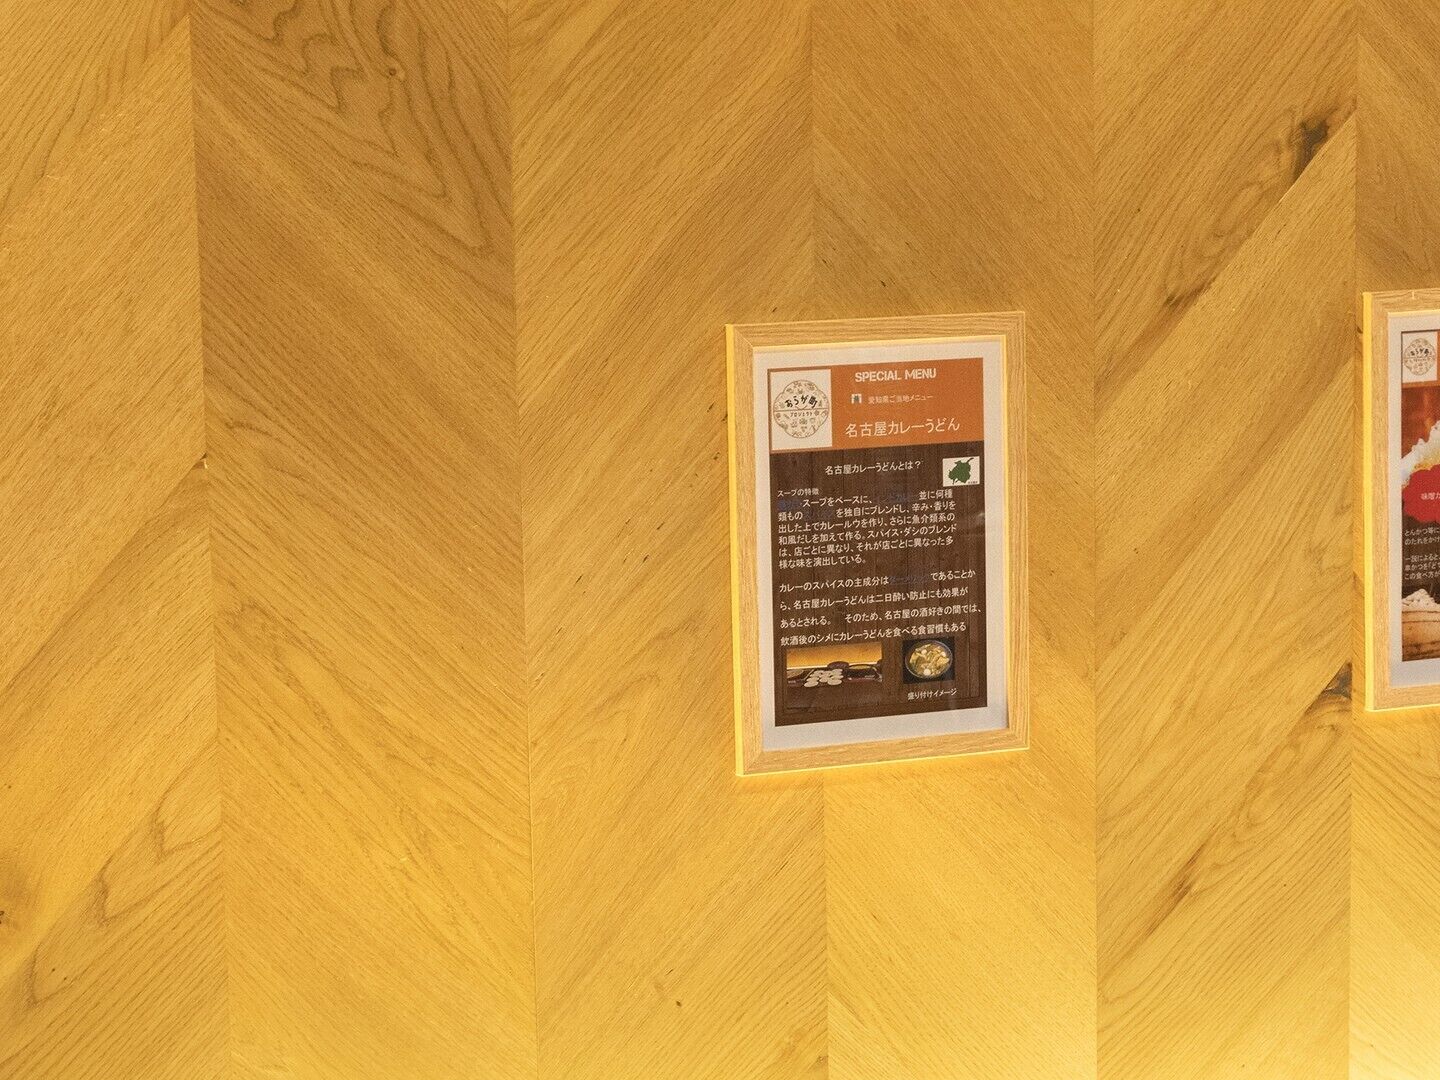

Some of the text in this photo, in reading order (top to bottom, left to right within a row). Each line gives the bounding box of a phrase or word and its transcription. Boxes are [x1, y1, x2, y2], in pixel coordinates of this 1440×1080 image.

[855, 368, 937, 383] SPECIAL MENU
[845, 417, 960, 437] 名古屋カレーうどん
[824, 461, 922, 476] 名古屋カレーうどんとは？
[777, 488, 819, 497] スープの特徴
[779, 555, 867, 569] 様な味を演出している。
[907, 688, 957, 701] 盛り付けイメージ
